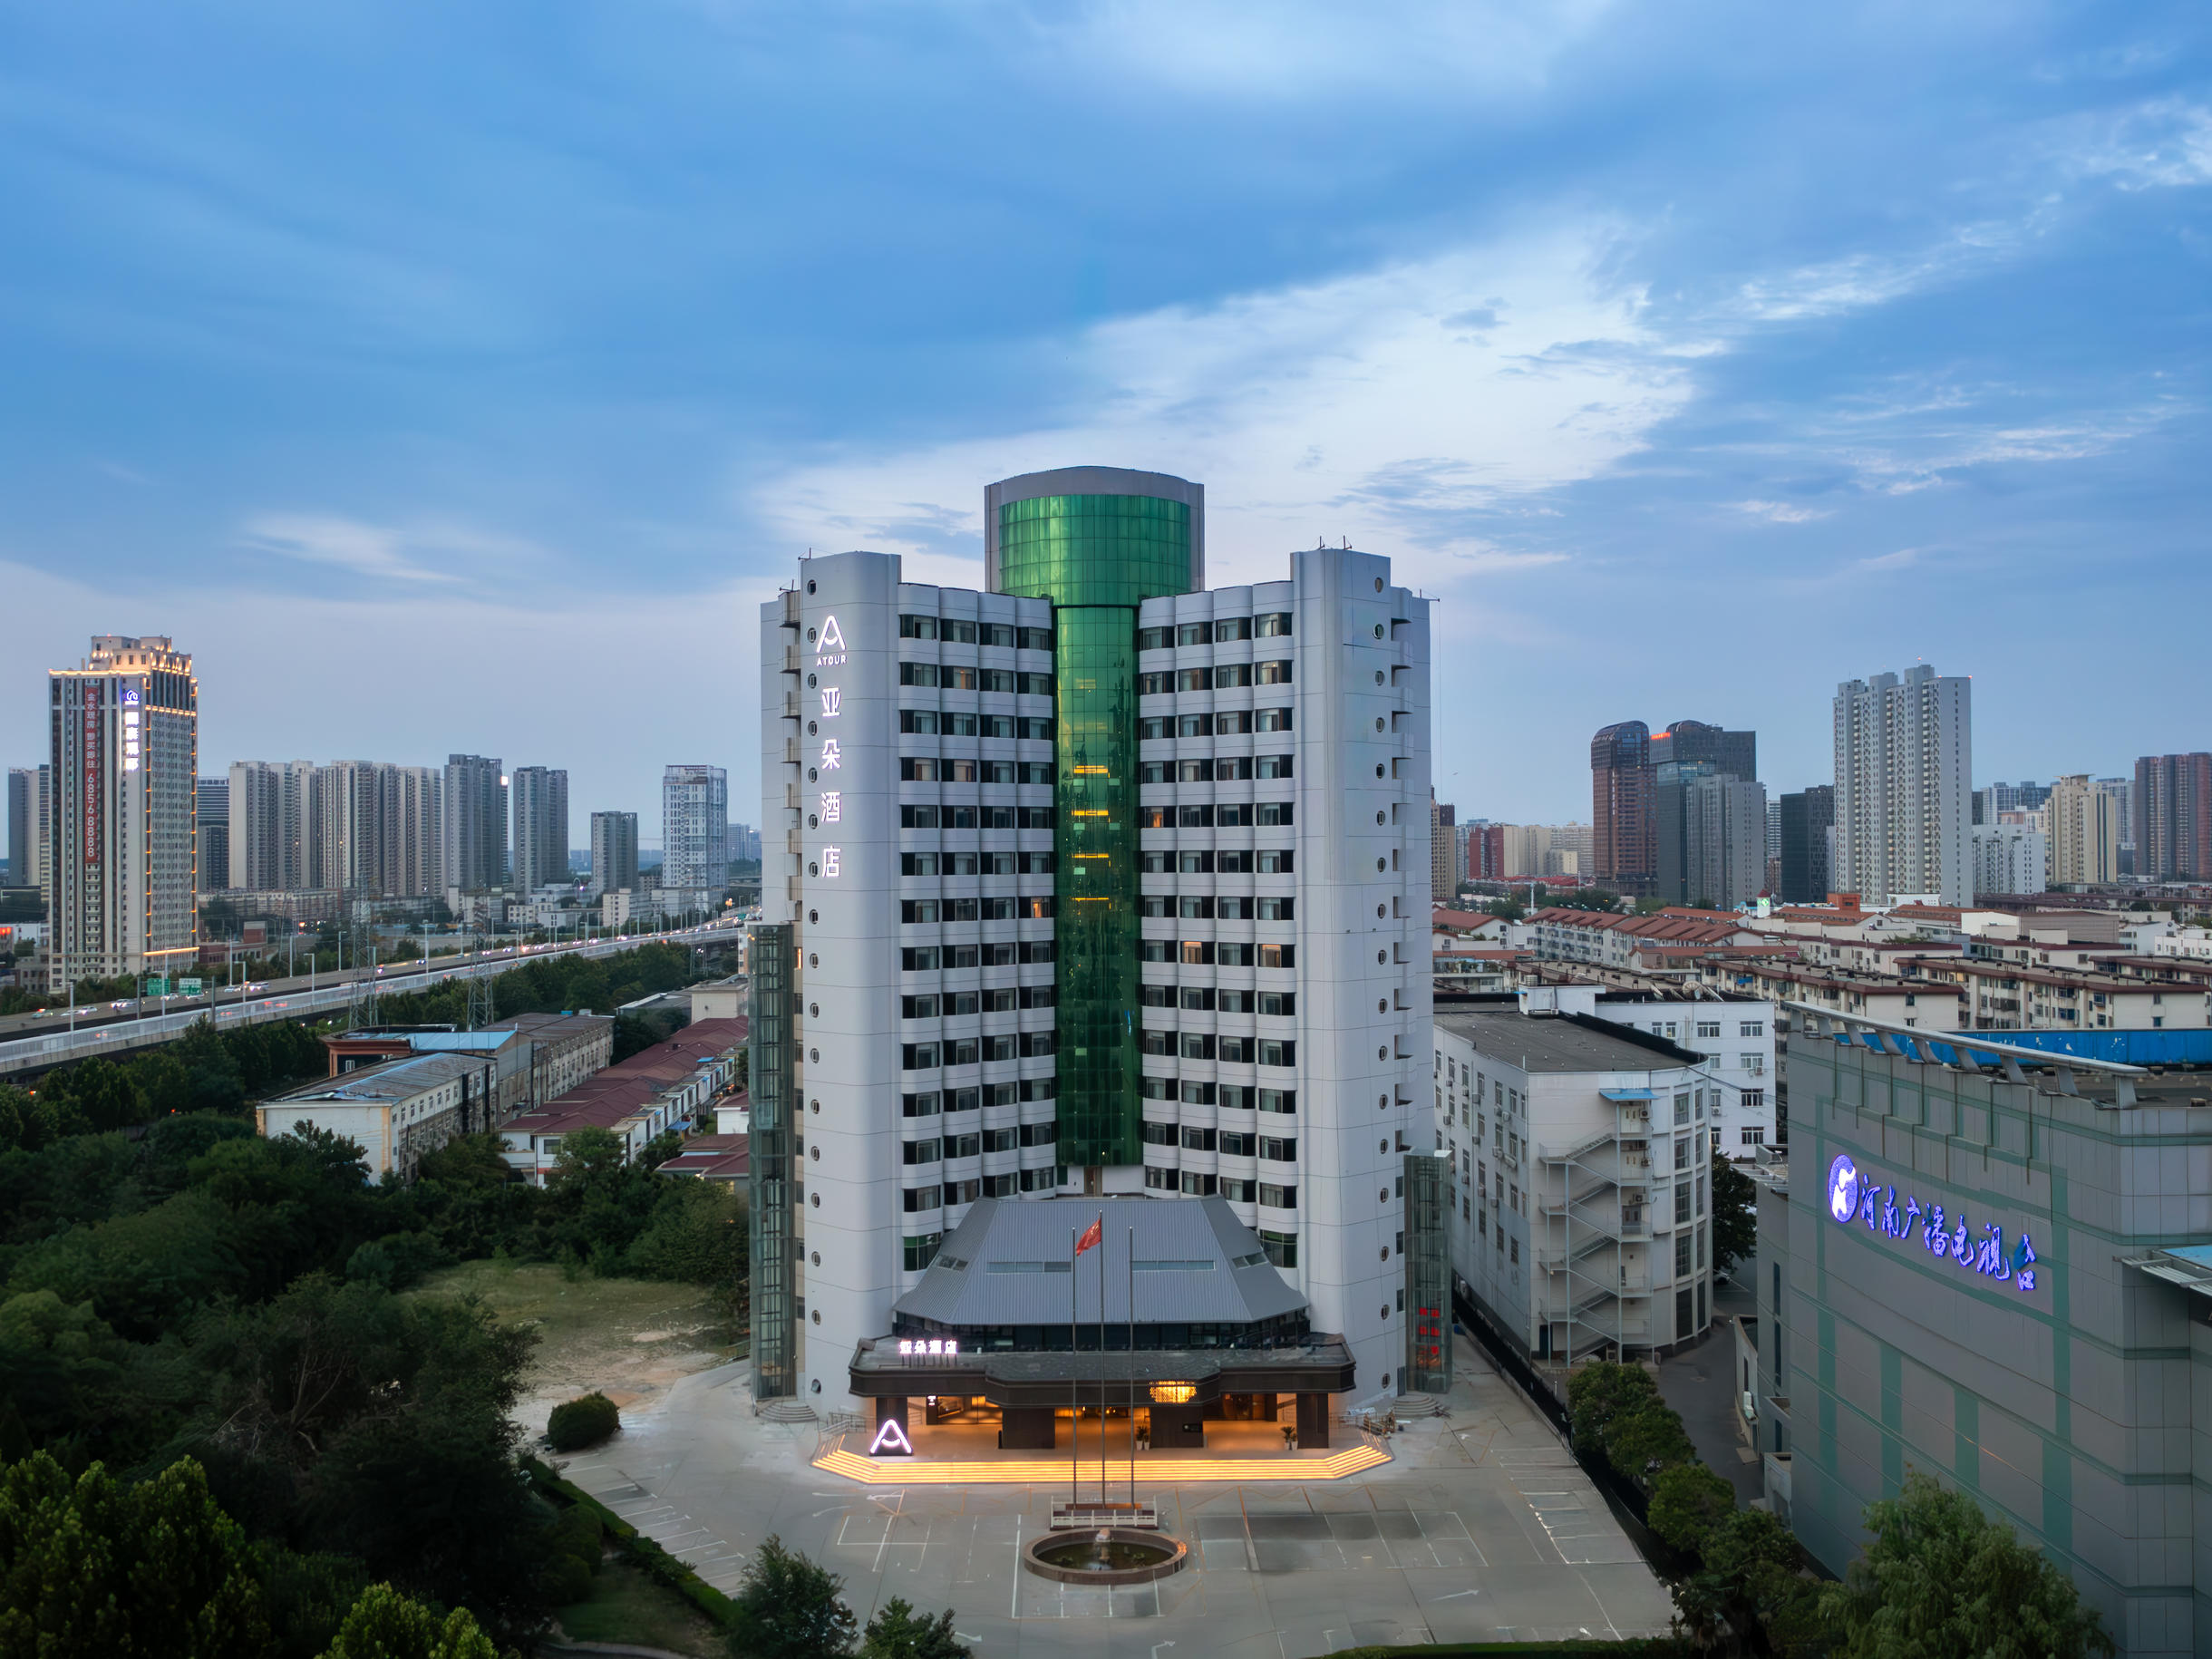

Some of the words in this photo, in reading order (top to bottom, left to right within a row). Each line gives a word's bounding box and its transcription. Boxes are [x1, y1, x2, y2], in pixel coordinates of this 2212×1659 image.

[817, 655, 847, 667] ATOUR
[87, 773, 95, 857] 68568888
[821, 687, 841, 878] 亚朵酒店
